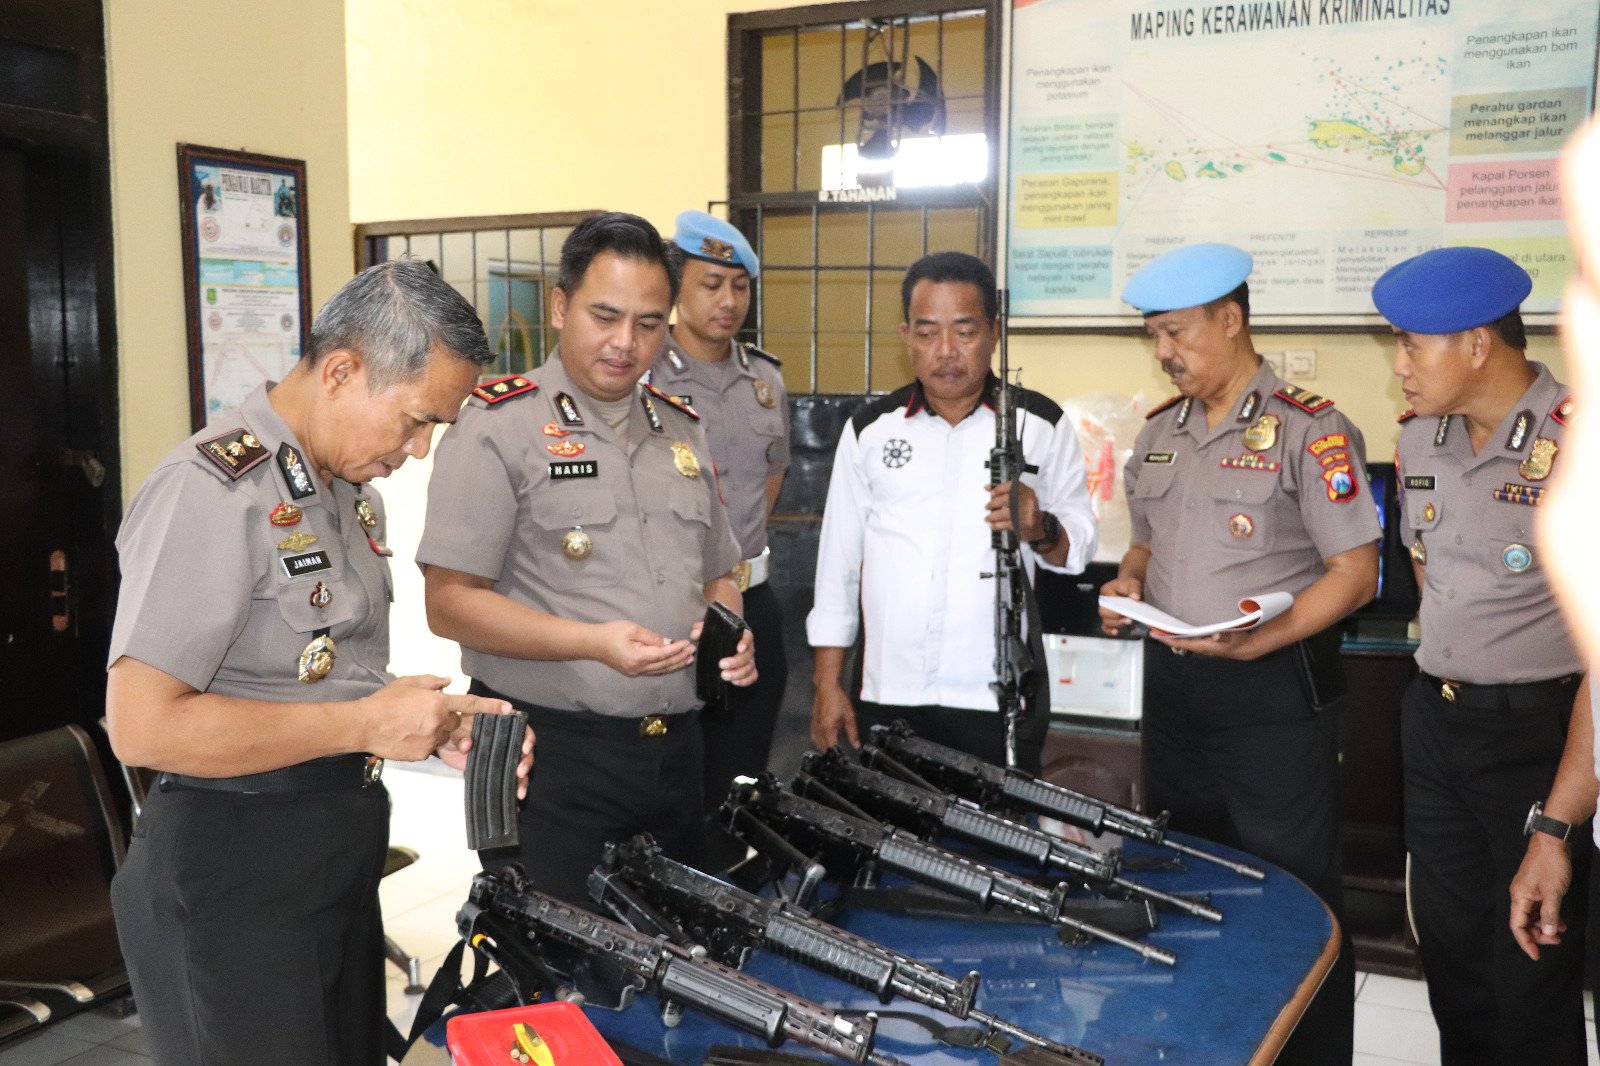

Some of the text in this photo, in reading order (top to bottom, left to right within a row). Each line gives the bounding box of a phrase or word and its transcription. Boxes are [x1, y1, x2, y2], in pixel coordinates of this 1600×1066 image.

[1131, 8, 1195, 41] MAPING
[1202, 0, 1310, 35] KERAWANAN
[1467, 27, 1577, 45] Penangkapan ikan
[1464, 42, 1578, 60] menggunakan bom
[1026, 64, 1111, 77] Penangkapan ikan
[1506, 60, 1531, 69] ikan
[1036, 78, 1101, 89] menggunakan
[1046, 91, 1088, 101] potasium
[1470, 99, 1562, 113] Perahu gardan
[1464, 112, 1566, 127] menangkap ikan
[1465, 126, 1563, 141] melanggar jalur
[1472, 169, 1550, 182] Kapal Porsen
[1022, 179, 1059, 188] Perairan
[1460, 182, 1559, 197] pelanggaran jalur
[1024, 190, 1108, 201] penangkapan ikan
[1020, 201, 1111, 213] menggunakan jaring
[1456, 196, 1562, 211] penangkapan ikan
[1043, 215, 1061, 223] mini
[1364, 229, 1409, 238] REPRESIF
[1522, 253, 1532, 263] di
[1535, 252, 1566, 263] utara
[554, 464, 593, 475] HARIS
[294, 555, 323, 569] JAIMAN
